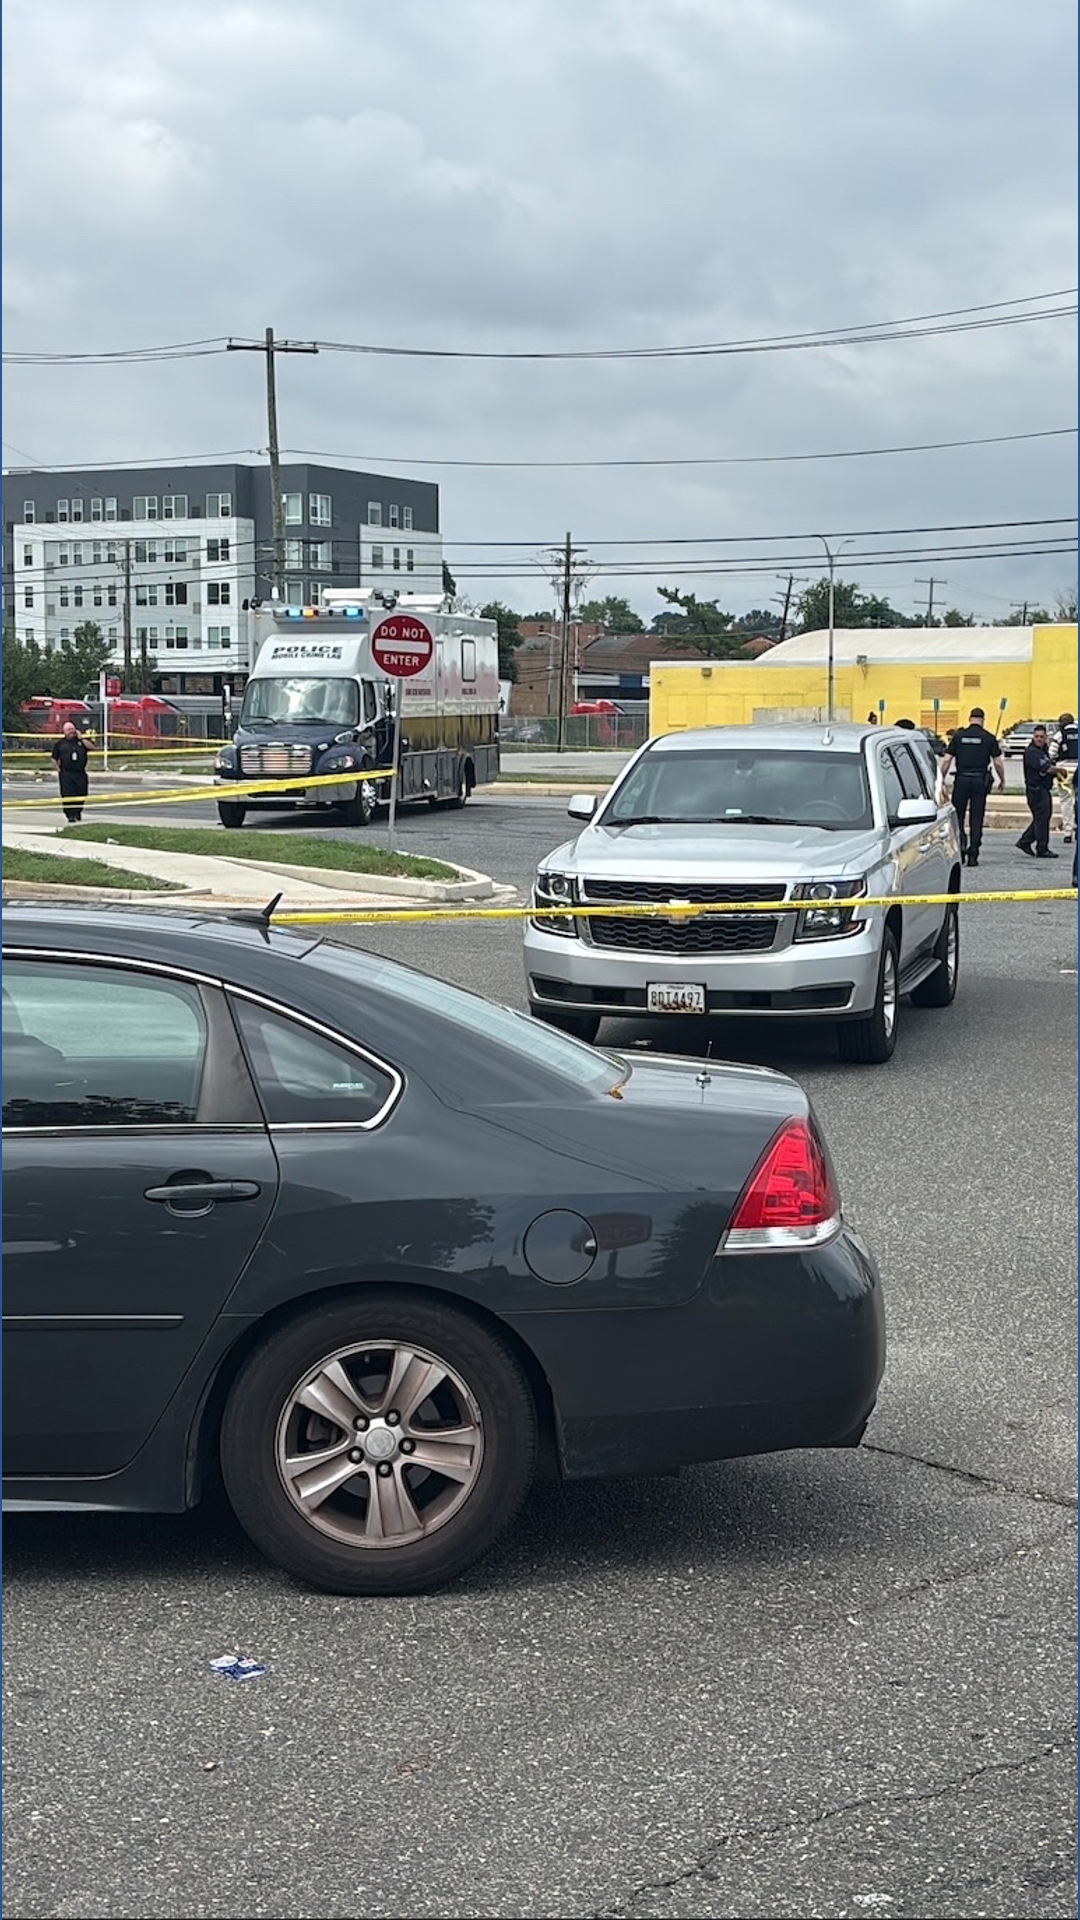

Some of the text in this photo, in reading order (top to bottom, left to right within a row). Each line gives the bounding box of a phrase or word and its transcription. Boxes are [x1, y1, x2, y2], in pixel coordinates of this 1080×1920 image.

[381, 625, 425, 639] DO NOT
[272, 645, 343, 654] POLICE
[271, 652, 299, 660] MOBILE
[383, 654, 420, 667] ENTER
